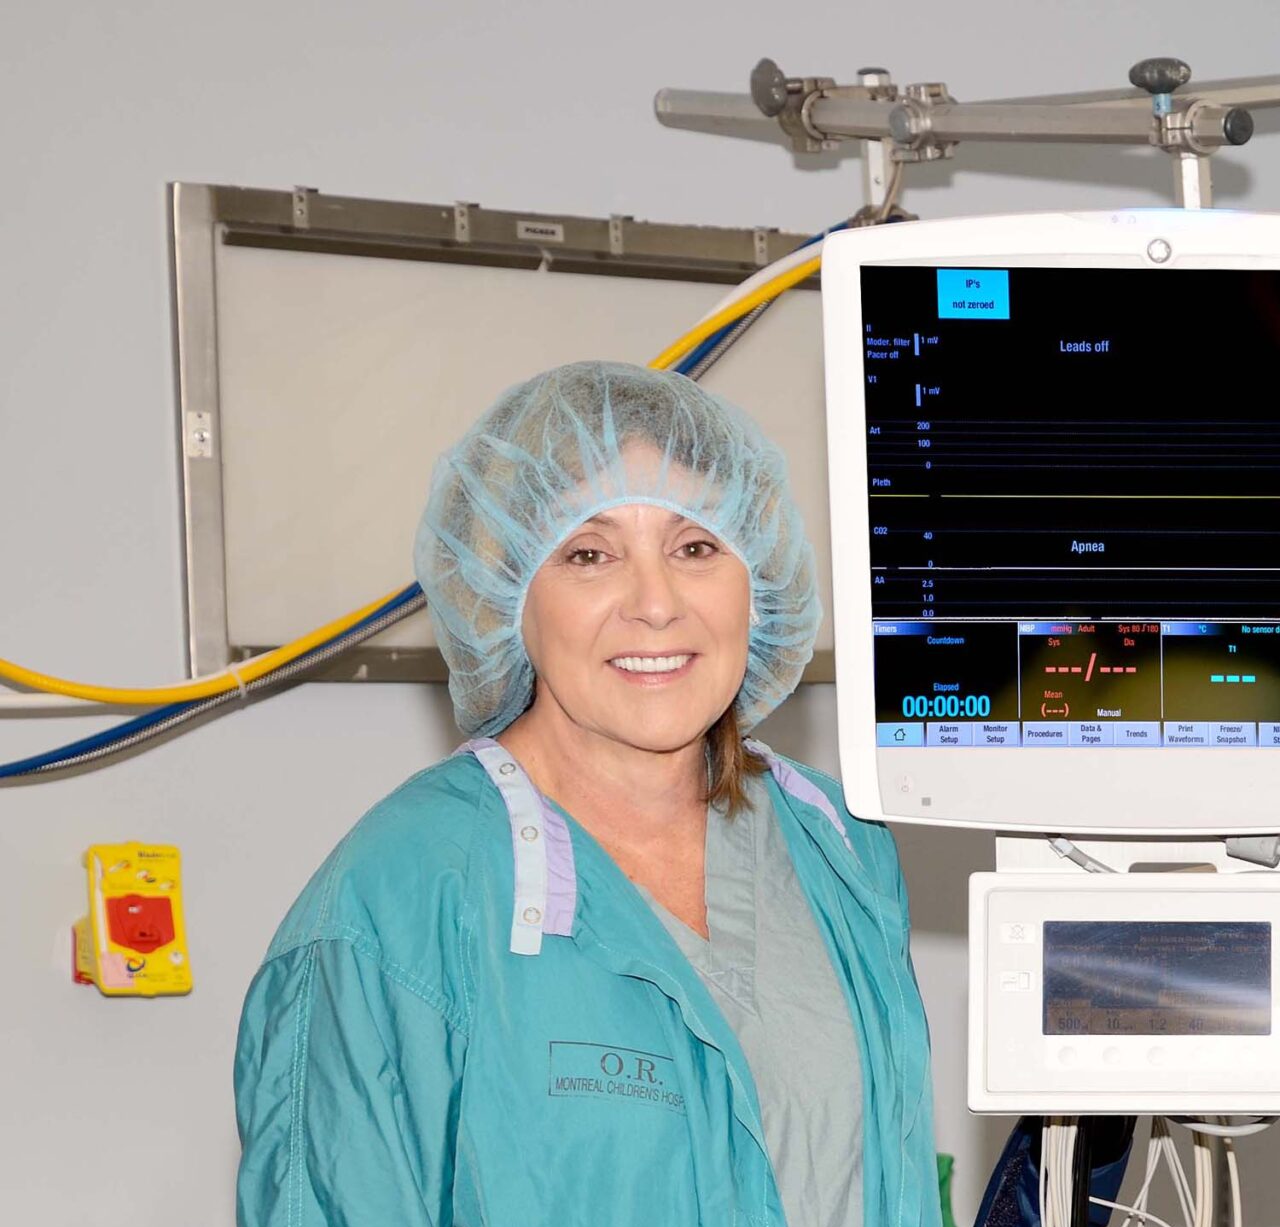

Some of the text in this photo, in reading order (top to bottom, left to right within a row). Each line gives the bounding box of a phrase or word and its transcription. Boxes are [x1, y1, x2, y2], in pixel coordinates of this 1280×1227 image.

[966, 279, 981, 289] IP's
[952, 300, 994, 310] not zeroed
[866, 338, 910, 347] Moder. filter
[927, 336, 939, 345] mV
[1060, 340, 1110, 353] Leads off
[867, 350, 899, 359] Pacer off
[868, 375, 878, 384] V1
[928, 386, 940, 395] mV
[869, 426, 881, 435] Art
[917, 422, 930, 430] 200
[917, 439, 931, 448] 100
[925, 461, 931, 470] 0
[872, 478, 891, 487] Pleth
[873, 526, 888, 535] CO2
[923, 532, 933, 540] 40
[1071, 540, 1105, 554] Apnea
[874, 576, 885, 584] AA
[922, 580, 934, 588] 2.5
[922, 594, 934, 602] 1.0
[922, 609, 934, 618] 0.0
[874, 624, 897, 633] Timers
[1078, 624, 1096, 633] Adult
[1118, 625, 1131, 634] Sys
[1162, 625, 1171, 633] T1
[1241, 625, 1251, 633] No
[1252, 625, 1274, 634] sensor
[927, 636, 965, 645] Countdown
[1048, 637, 1061, 647] Sys
[1229, 645, 1237, 653] T1
[933, 682, 960, 692] Elapsed
[1044, 690, 1063, 699] Mean
[902, 695, 991, 718] 00:00:00
[1097, 708, 1121, 717] Manual
[939, 725, 959, 733] Alarm
[983, 724, 1008, 733] Monitor
[1080, 724, 1096, 732] Data
[1178, 724, 1194, 733] Print
[1220, 725, 1243, 733] Freeze/
[1027, 729, 1063, 739] Procedures
[1126, 730, 1148, 738] Trends
[940, 735, 959, 745] Setup
[986, 735, 1005, 745] Setup
[1081, 735, 1101, 744] Pages
[1168, 735, 1204, 744] Waveforms
[1216, 736, 1247, 745] Snapshot
[600, 1052, 664, 1086] O.R.
[555, 1076, 604, 1093] MONTREAL
